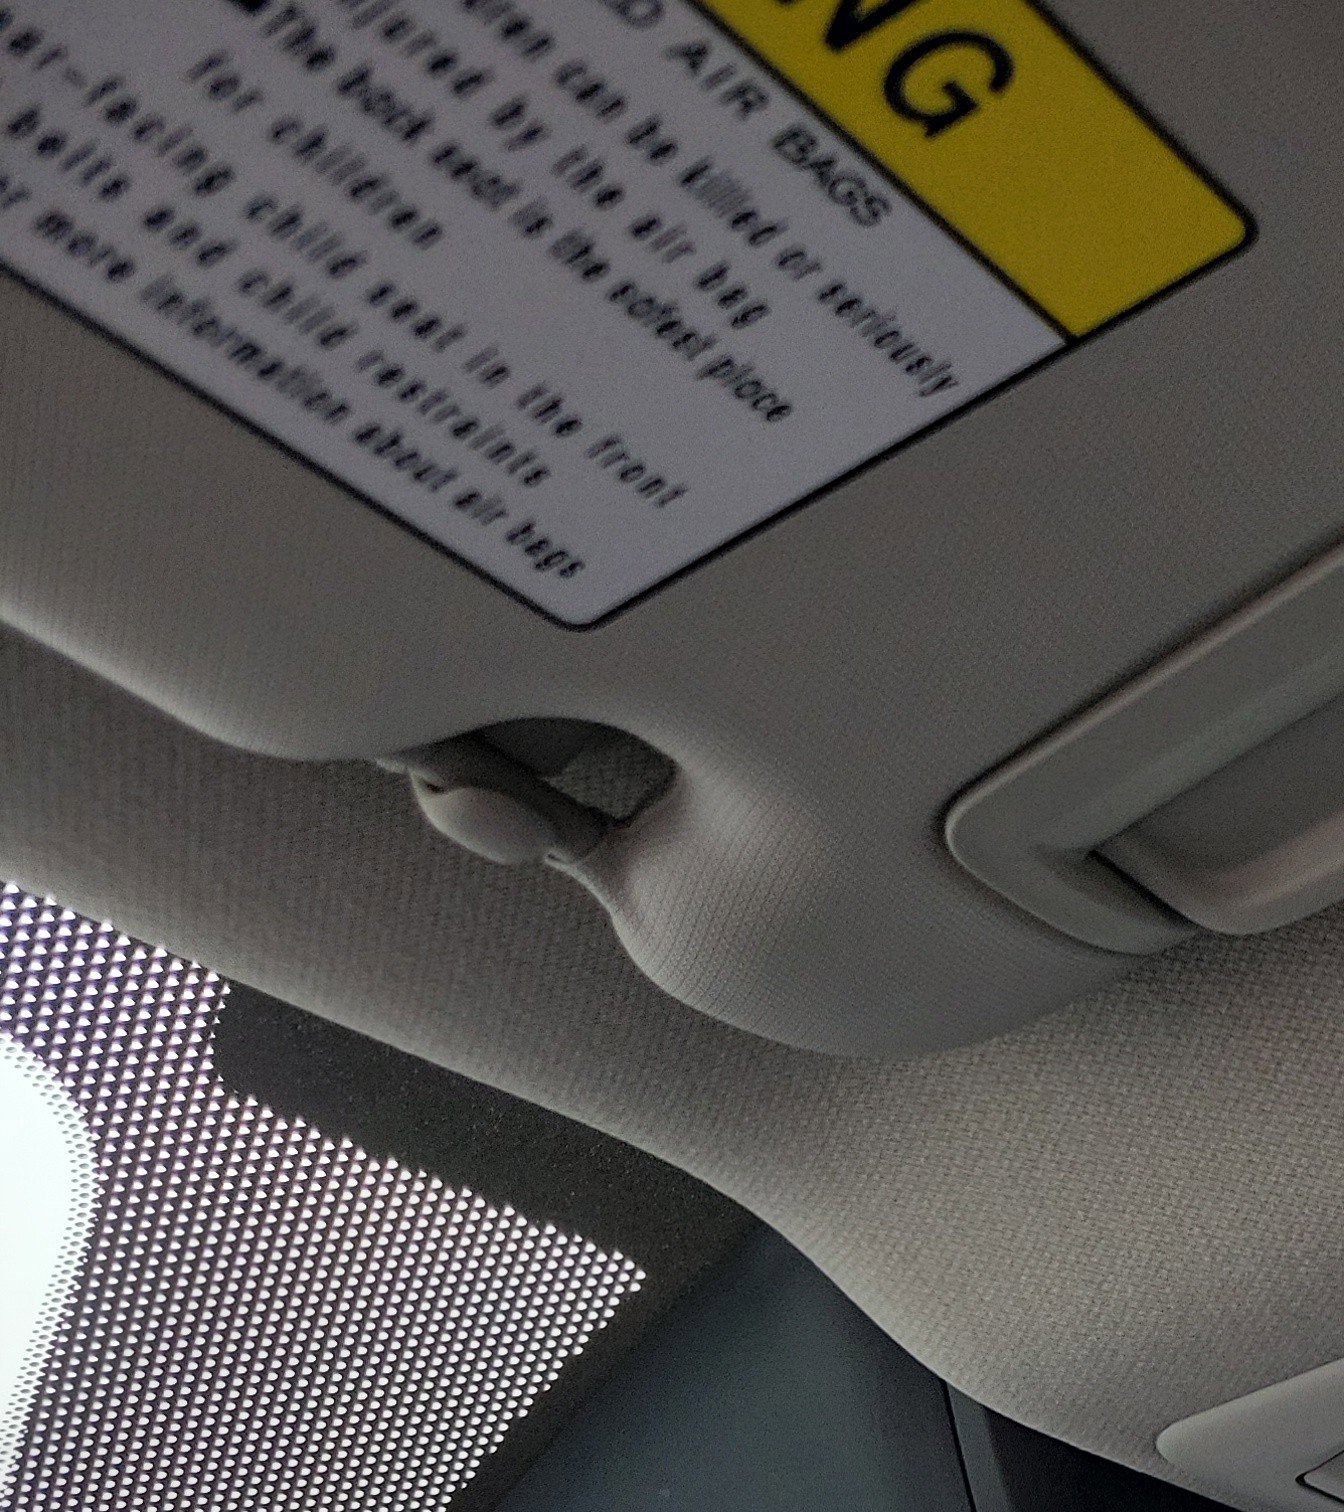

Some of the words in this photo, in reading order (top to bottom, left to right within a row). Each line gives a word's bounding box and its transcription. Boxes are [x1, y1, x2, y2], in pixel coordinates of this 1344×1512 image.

[3, 103, 132, 201] belts
[141, 203, 241, 268] and
[237, 267, 360, 351] child
[353, 348, 553, 485] restraints
[185, 50, 265, 114] for
[266, 113, 446, 252] children
[255, 0, 336, 72] The
[335, 62, 436, 141] back
[428, 140, 522, 211] seat
[509, 195, 554, 241] is
[547, 228, 611, 283] the
[605, 278, 720, 360] safest
[694, 353, 793, 423] place
[488, 93, 552, 151] by
[551, 147, 626, 211] the
[630, 213, 696, 264] air
[695, 259, 770, 330] bag
[553, 60, 628, 121] can
[625, 114, 678, 163] be
[677, 153, 790, 248] killed
[776, 246, 822, 281] or
[816, 279, 959, 398] seriously
[662, 40, 770, 121] AIR
[767, 122, 893, 228] BAGS
[34, 206, 138, 283] more
[140, 275, 351, 426] information
[352, 421, 461, 494] about
[452, 487, 509, 527] air
[504, 516, 587, 579] bags
[241, 192, 371, 280] child
[365, 278, 467, 353] seat
[461, 345, 512, 389] in
[513, 379, 584, 440] the
[583, 432, 690, 508] front
